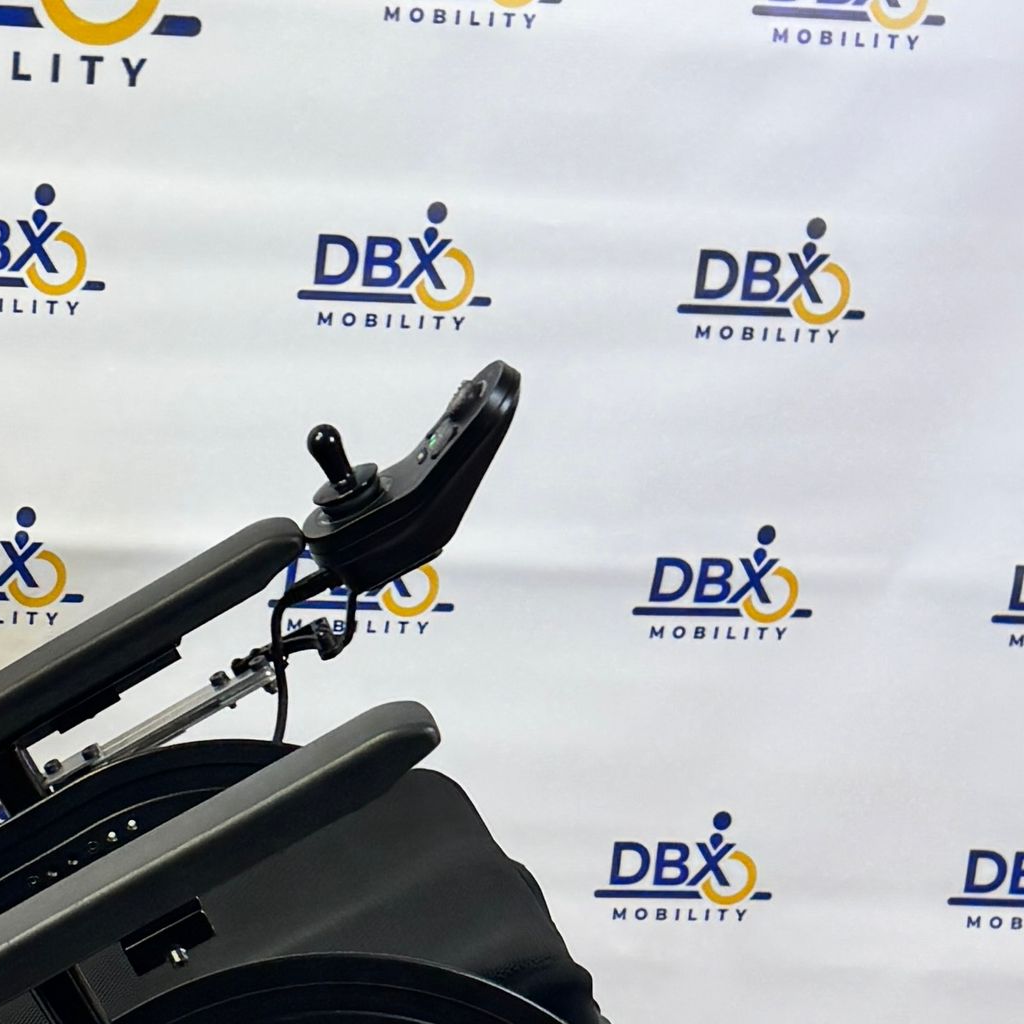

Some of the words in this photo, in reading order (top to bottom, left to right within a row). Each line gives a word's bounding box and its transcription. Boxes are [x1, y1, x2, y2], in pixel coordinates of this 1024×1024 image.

[384, 6, 536, 29] MOBILITY
[773, 28, 919, 51] MOBILITY
[314, 234, 452, 290] DBX
[694, 249, 830, 304] DBX
[316, 311, 466, 331] MOBILITY
[695, 325, 839, 344] MOBILITY
[648, 557, 779, 604] DBX
[648, 625, 787, 641] MOBILITY
[609, 841, 736, 887] DBX
[612, 907, 747, 922] MOBILITY
